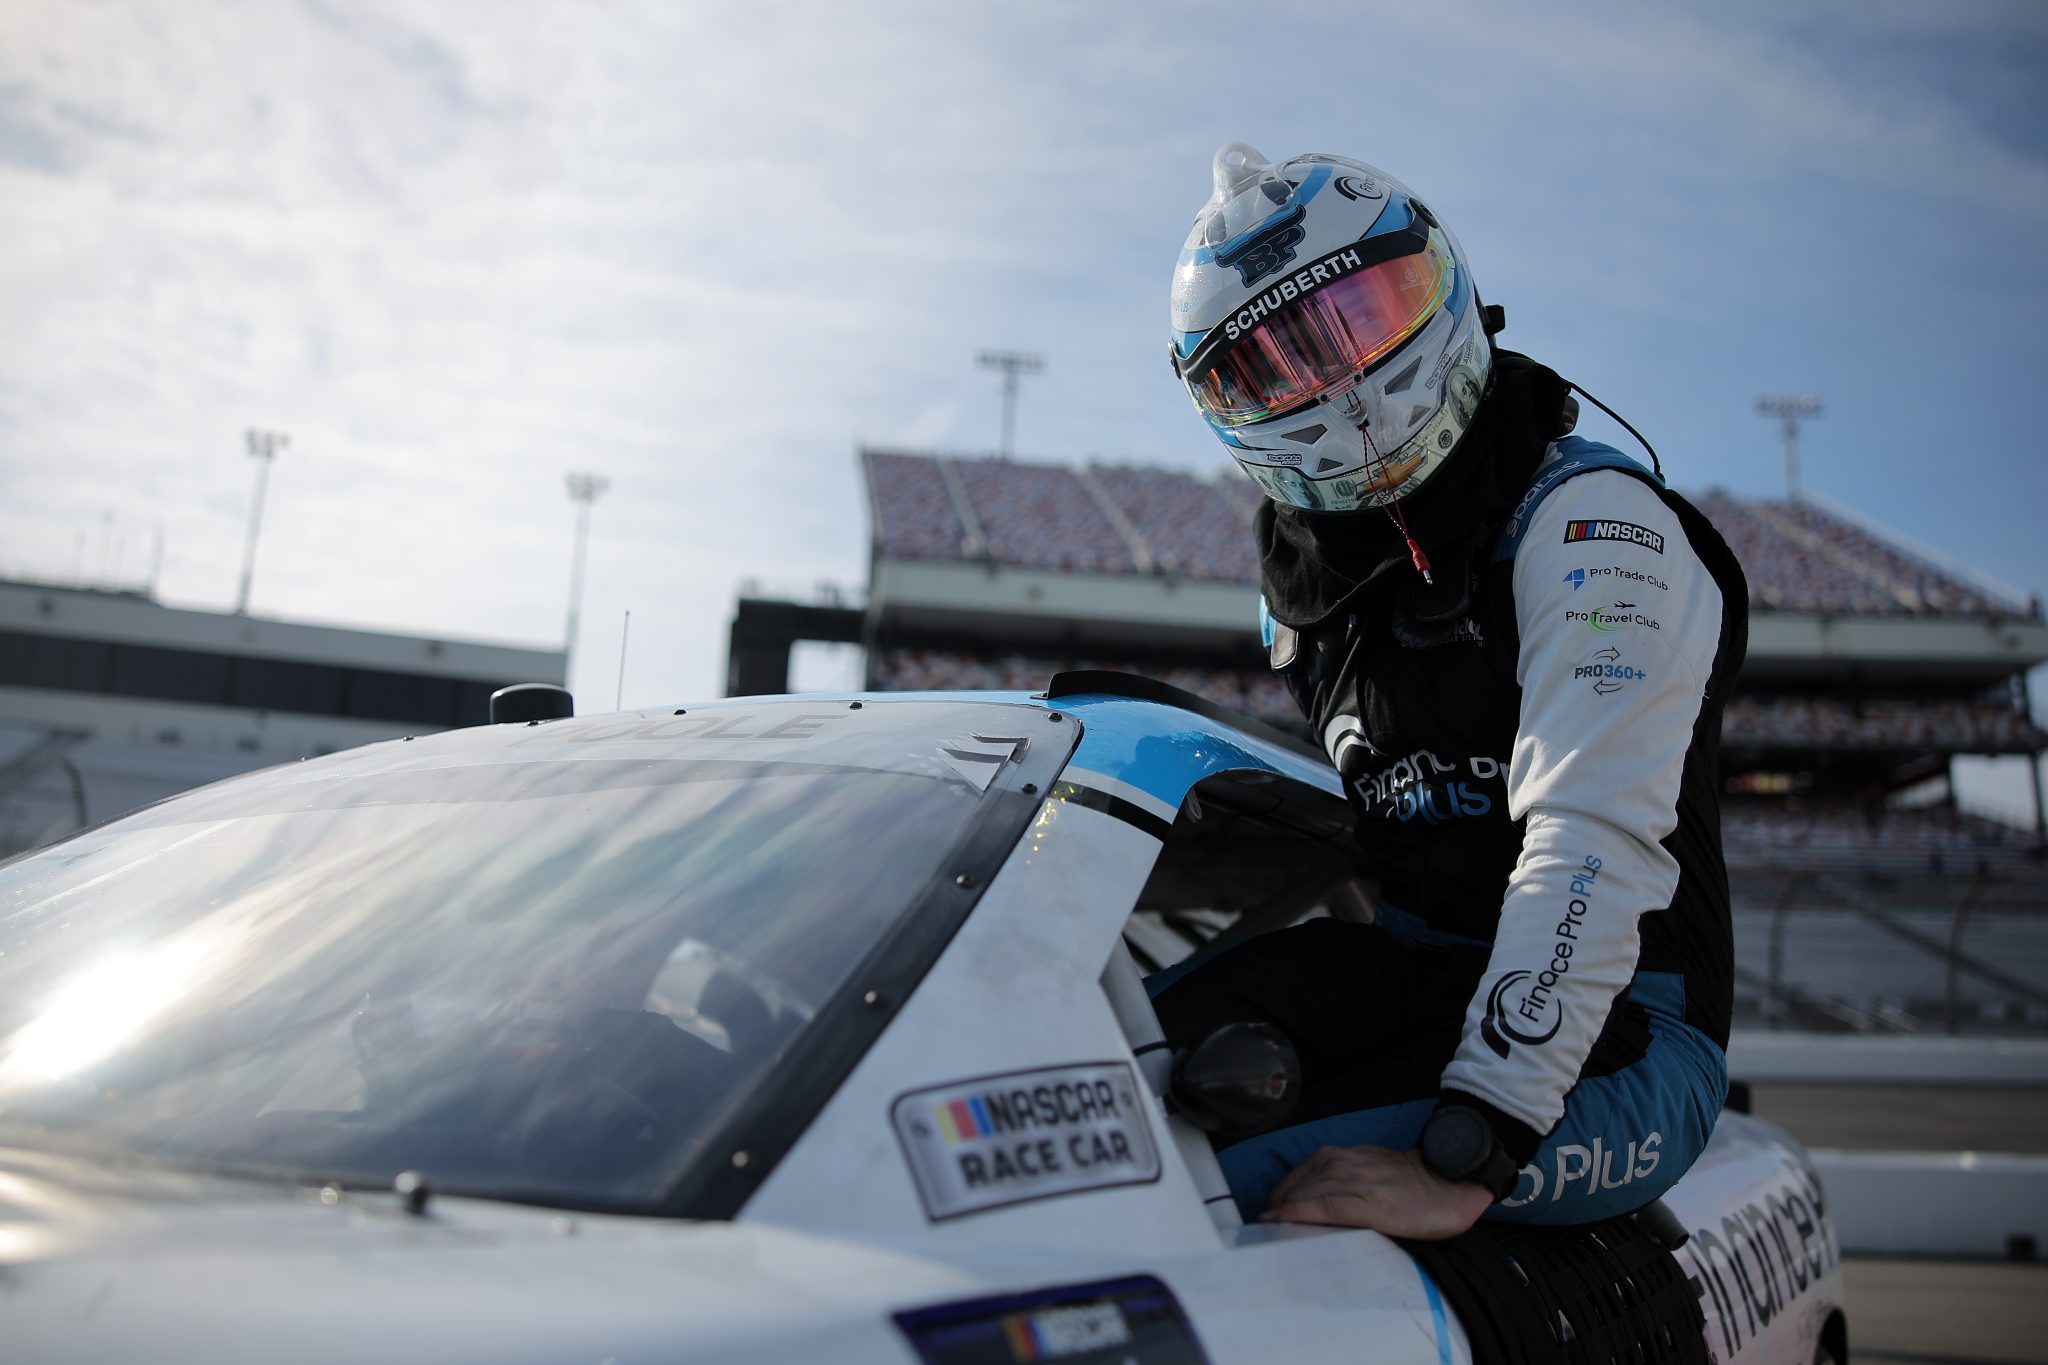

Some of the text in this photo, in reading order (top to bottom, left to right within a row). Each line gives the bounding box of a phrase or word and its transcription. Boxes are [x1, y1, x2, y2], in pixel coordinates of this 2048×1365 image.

[1224, 249, 1363, 341] SCHUBERTH
[1593, 521, 1664, 552] NASCAR
[1589, 566, 1669, 592] Pro Trade Club
[1565, 611, 1660, 631] Pro Travel Club
[1574, 664, 1646, 680] PRO360+
[1569, 854, 1602, 897] Plus
[1556, 899, 1587, 940] Pro
[985, 1080, 1121, 1132] NASCAR
[957, 1130, 1136, 1189] RACE CAR
[1552, 1131, 1662, 1201] Plus
